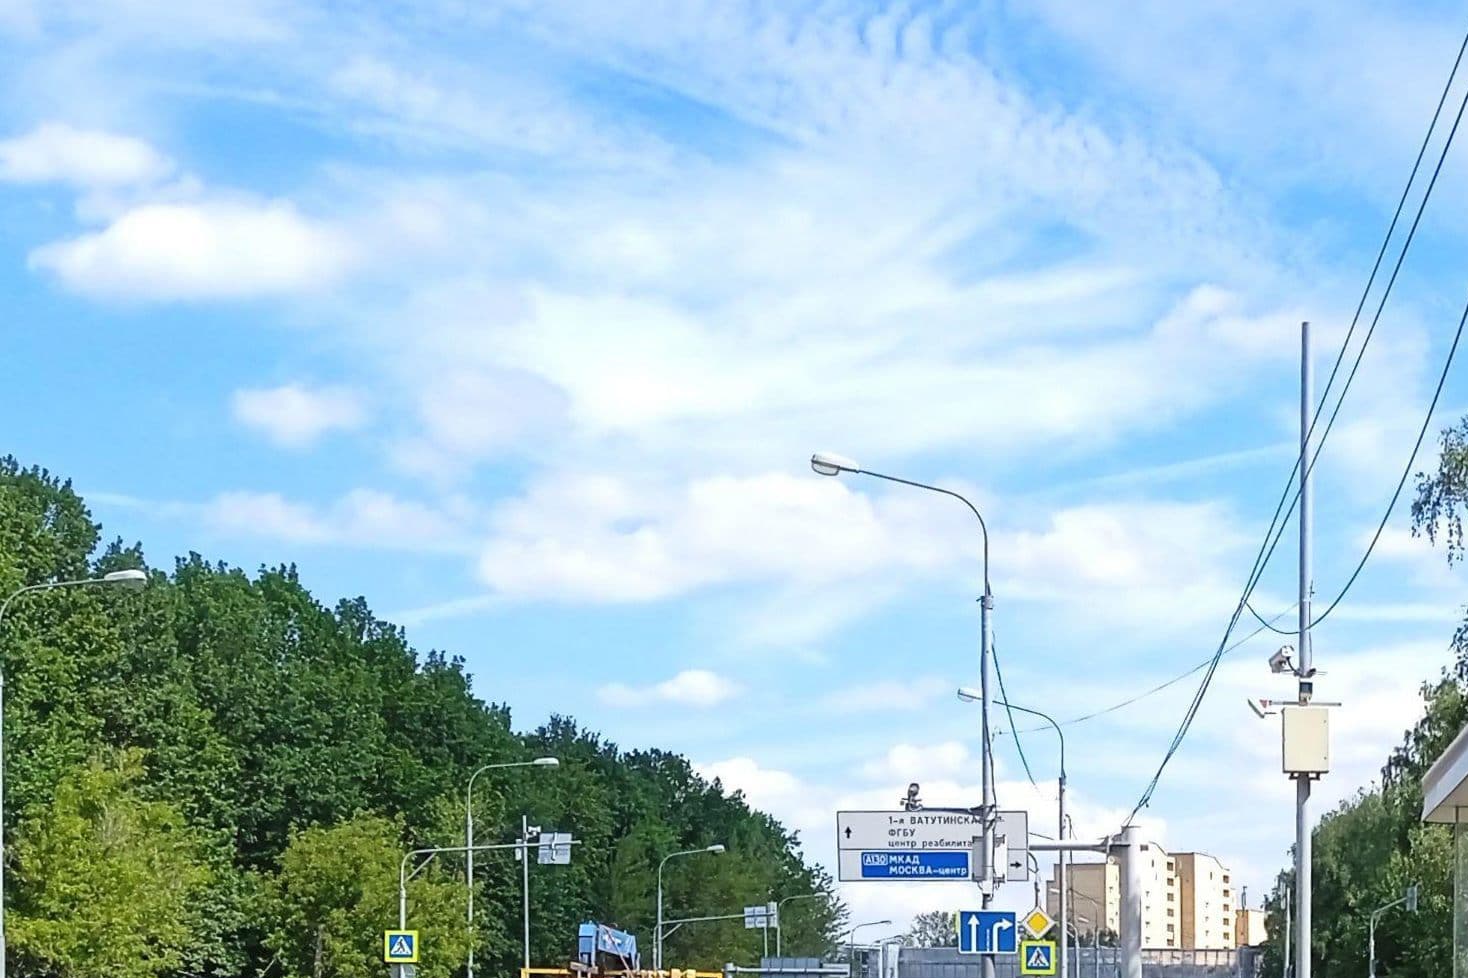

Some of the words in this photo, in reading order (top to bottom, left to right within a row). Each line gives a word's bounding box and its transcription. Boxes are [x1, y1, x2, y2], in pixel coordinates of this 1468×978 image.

[889, 816, 905, 824] 1-я
[910, 816, 981, 824] ВАТУТИНСКА
[888, 828, 916, 837] ФГБУ
[888, 840, 917, 849] центр
[922, 838, 973, 849] реабилита
[889, 855, 920, 865] МКАД
